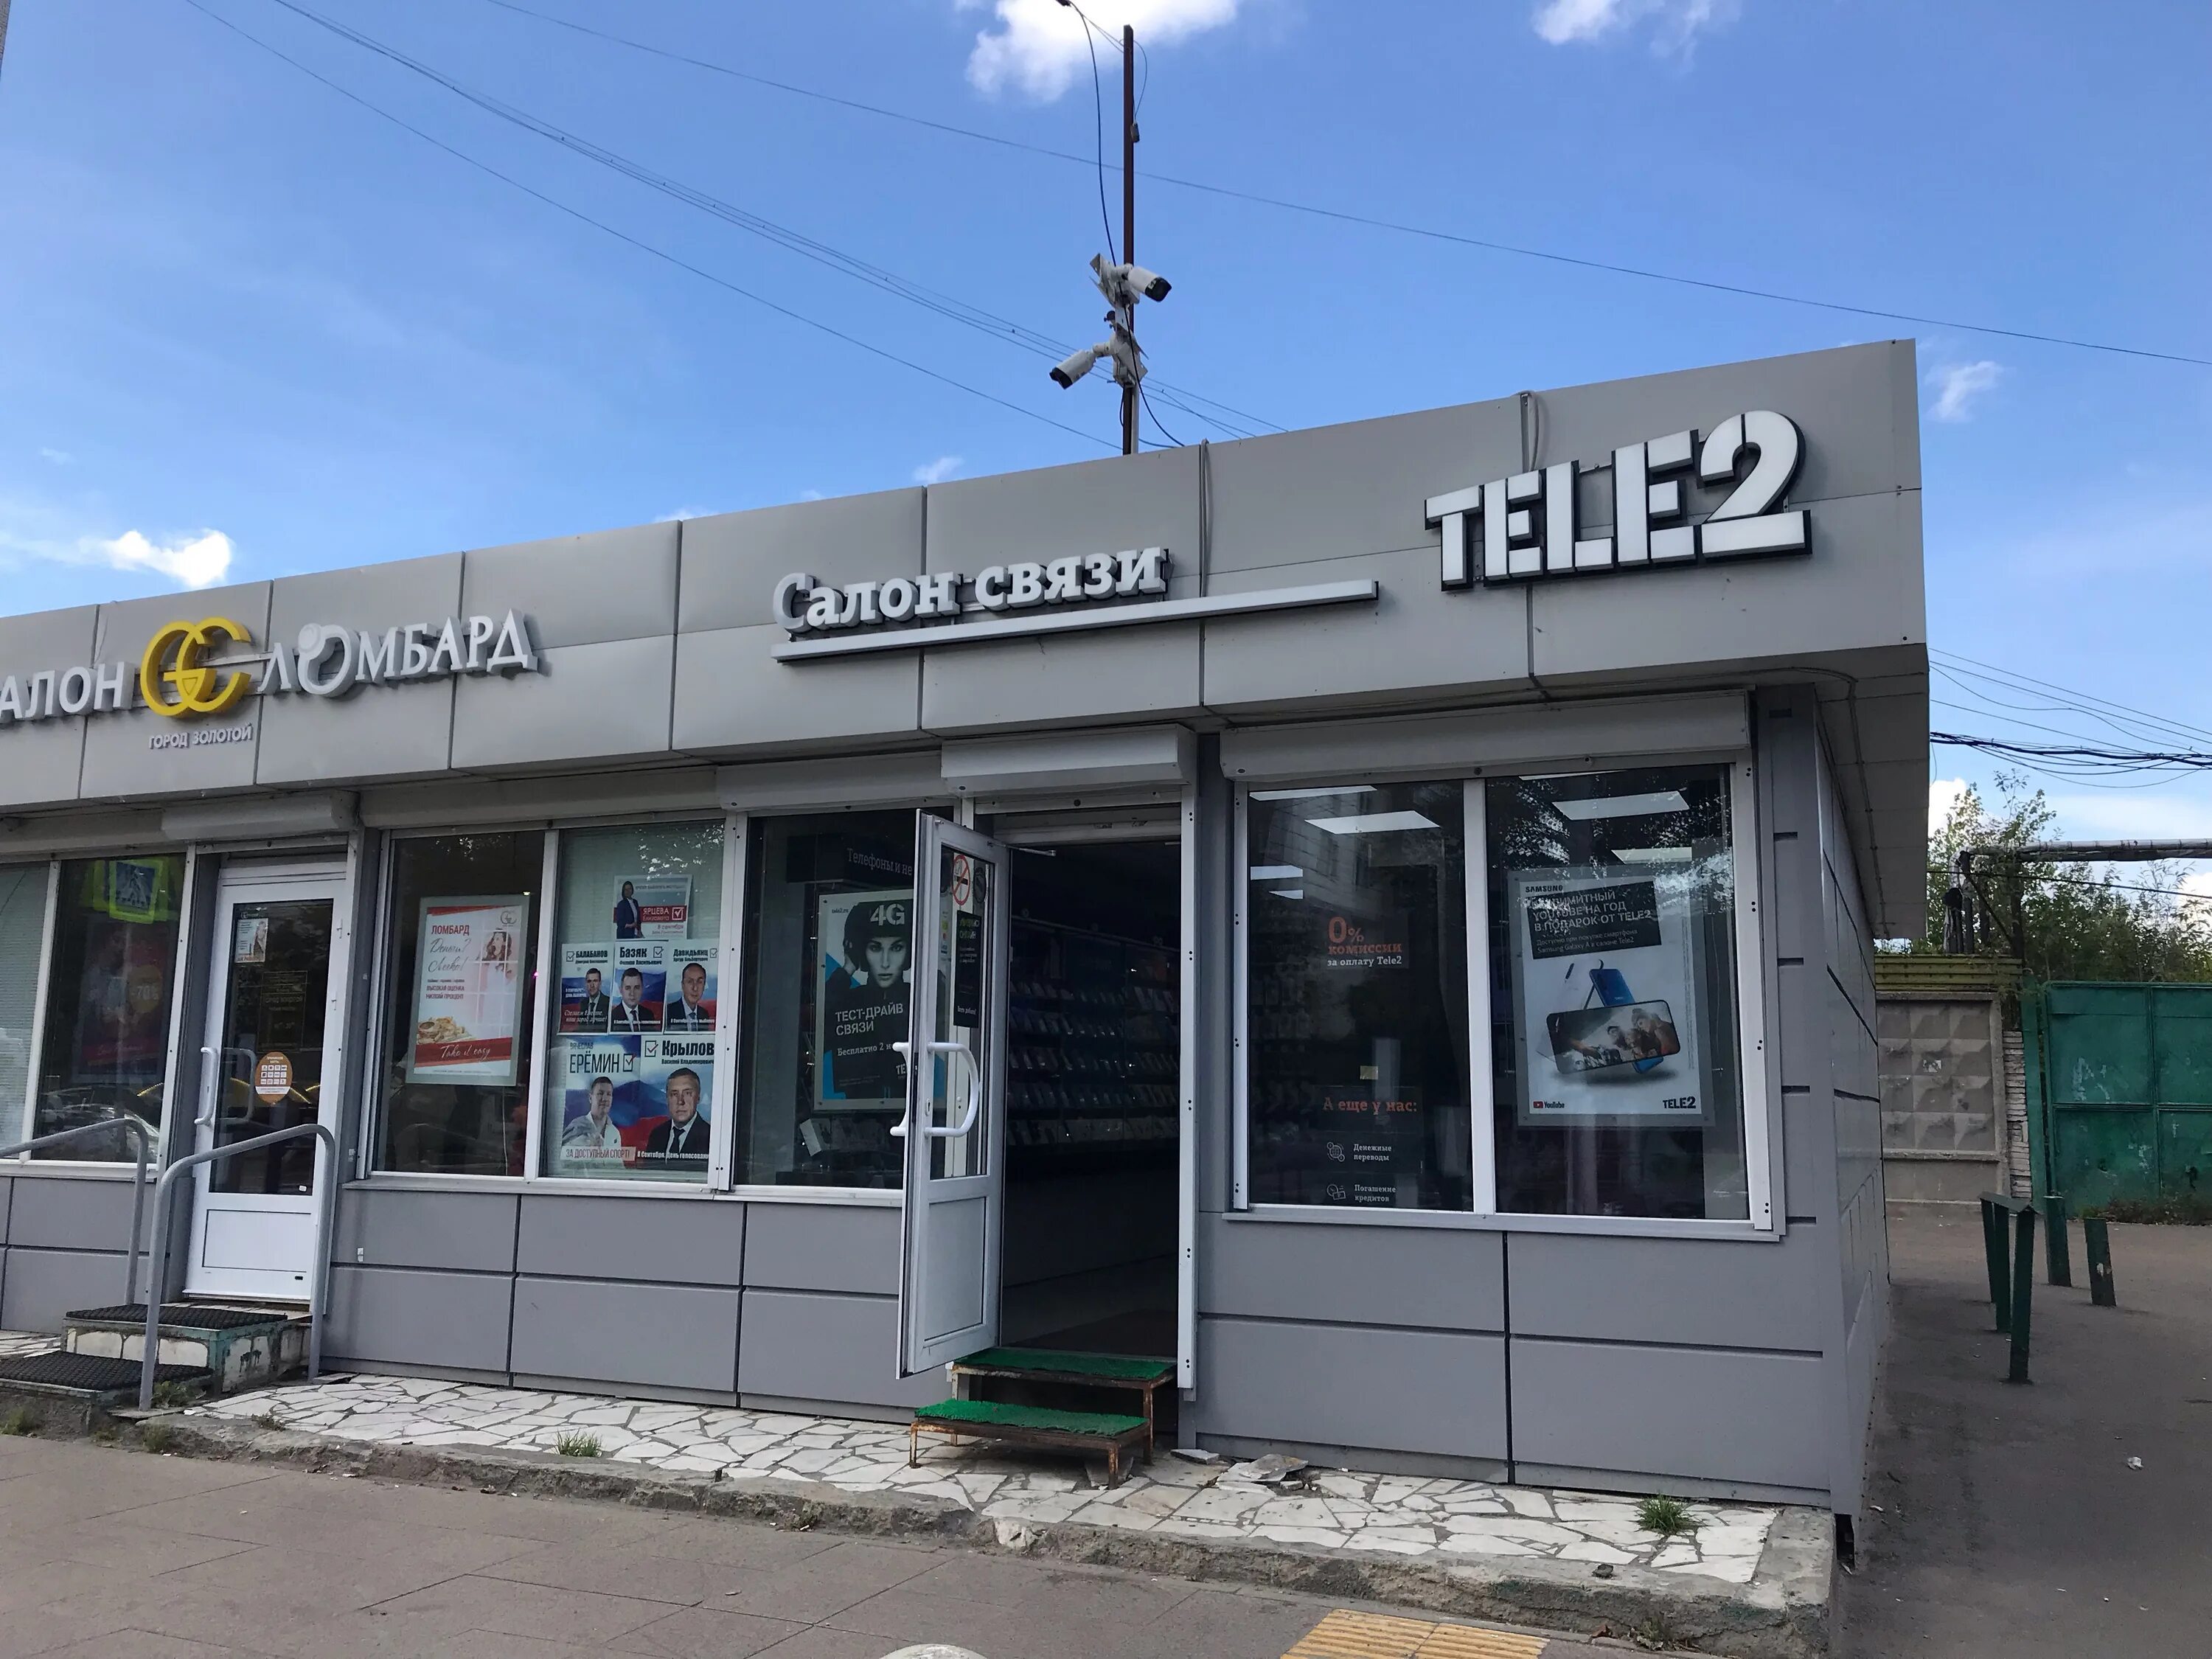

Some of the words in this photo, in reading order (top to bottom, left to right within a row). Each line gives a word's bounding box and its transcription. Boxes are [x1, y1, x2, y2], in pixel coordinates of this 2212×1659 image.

[1425, 411, 1812, 591] TELE2
[773, 571, 960, 633] Салон
[975, 547, 1166, 609] связи
[257, 608, 538, 698] ЛОМБАРД
[149, 732, 189, 749] ГОРОД
[193, 723, 253, 745] ЗОЛОТОЙ
[846, 847, 894, 872] Телефоны
[1526, 885, 1563, 893] SAMSUNG
[643, 907, 669, 915] ЯРЦЕВА
[870, 903, 905, 926] 4G
[1585, 905, 1601, 916] НА
[1604, 901, 1627, 913] ГОД
[1544, 916, 1599, 932] ПОДАРОК
[1601, 914, 1615, 923] ОТ
[1618, 910, 1652, 922] TELE2
[431, 925, 470, 936] ЛОМБАРД
[1329, 917, 1364, 943] 0%
[620, 947, 647, 958] Базяк
[673, 949, 708, 957] Давидьянц
[1328, 944, 1402, 955] комиссии
[1340, 958, 1374, 967] оплату
[1377, 956, 1402, 965] Tele2
[835, 1001, 904, 1022] ТЕСТ-ДРАЙВ
[836, 1020, 874, 1035] СВЯЗИ
[440, 1045, 461, 1059] Take
[473, 1048, 491, 1060] easy
[661, 1040, 714, 1057] Крылов
[837, 1045, 877, 1057] Бесплатно
[879, 1043, 884, 1051] 2
[570, 1051, 619, 1074] ЕРЁМИН
[1323, 1097, 1333, 1110] А
[1338, 1100, 1368, 1113] еще
[1371, 1101, 1381, 1115] у
[1386, 1101, 1417, 1112] нас:
[1543, 1101, 1565, 1109] YouTube
[1662, 1096, 1697, 1110] TELE2
[566, 1149, 574, 1158] ЗА
[574, 1147, 609, 1159] ДОСТУПНЫЙ
[1353, 1144, 1392, 1152] Денежные
[1354, 1154, 1389, 1163] переводы
[1354, 1184, 1397, 1193] Погашение
[1354, 1195, 1389, 1203] кредитов
